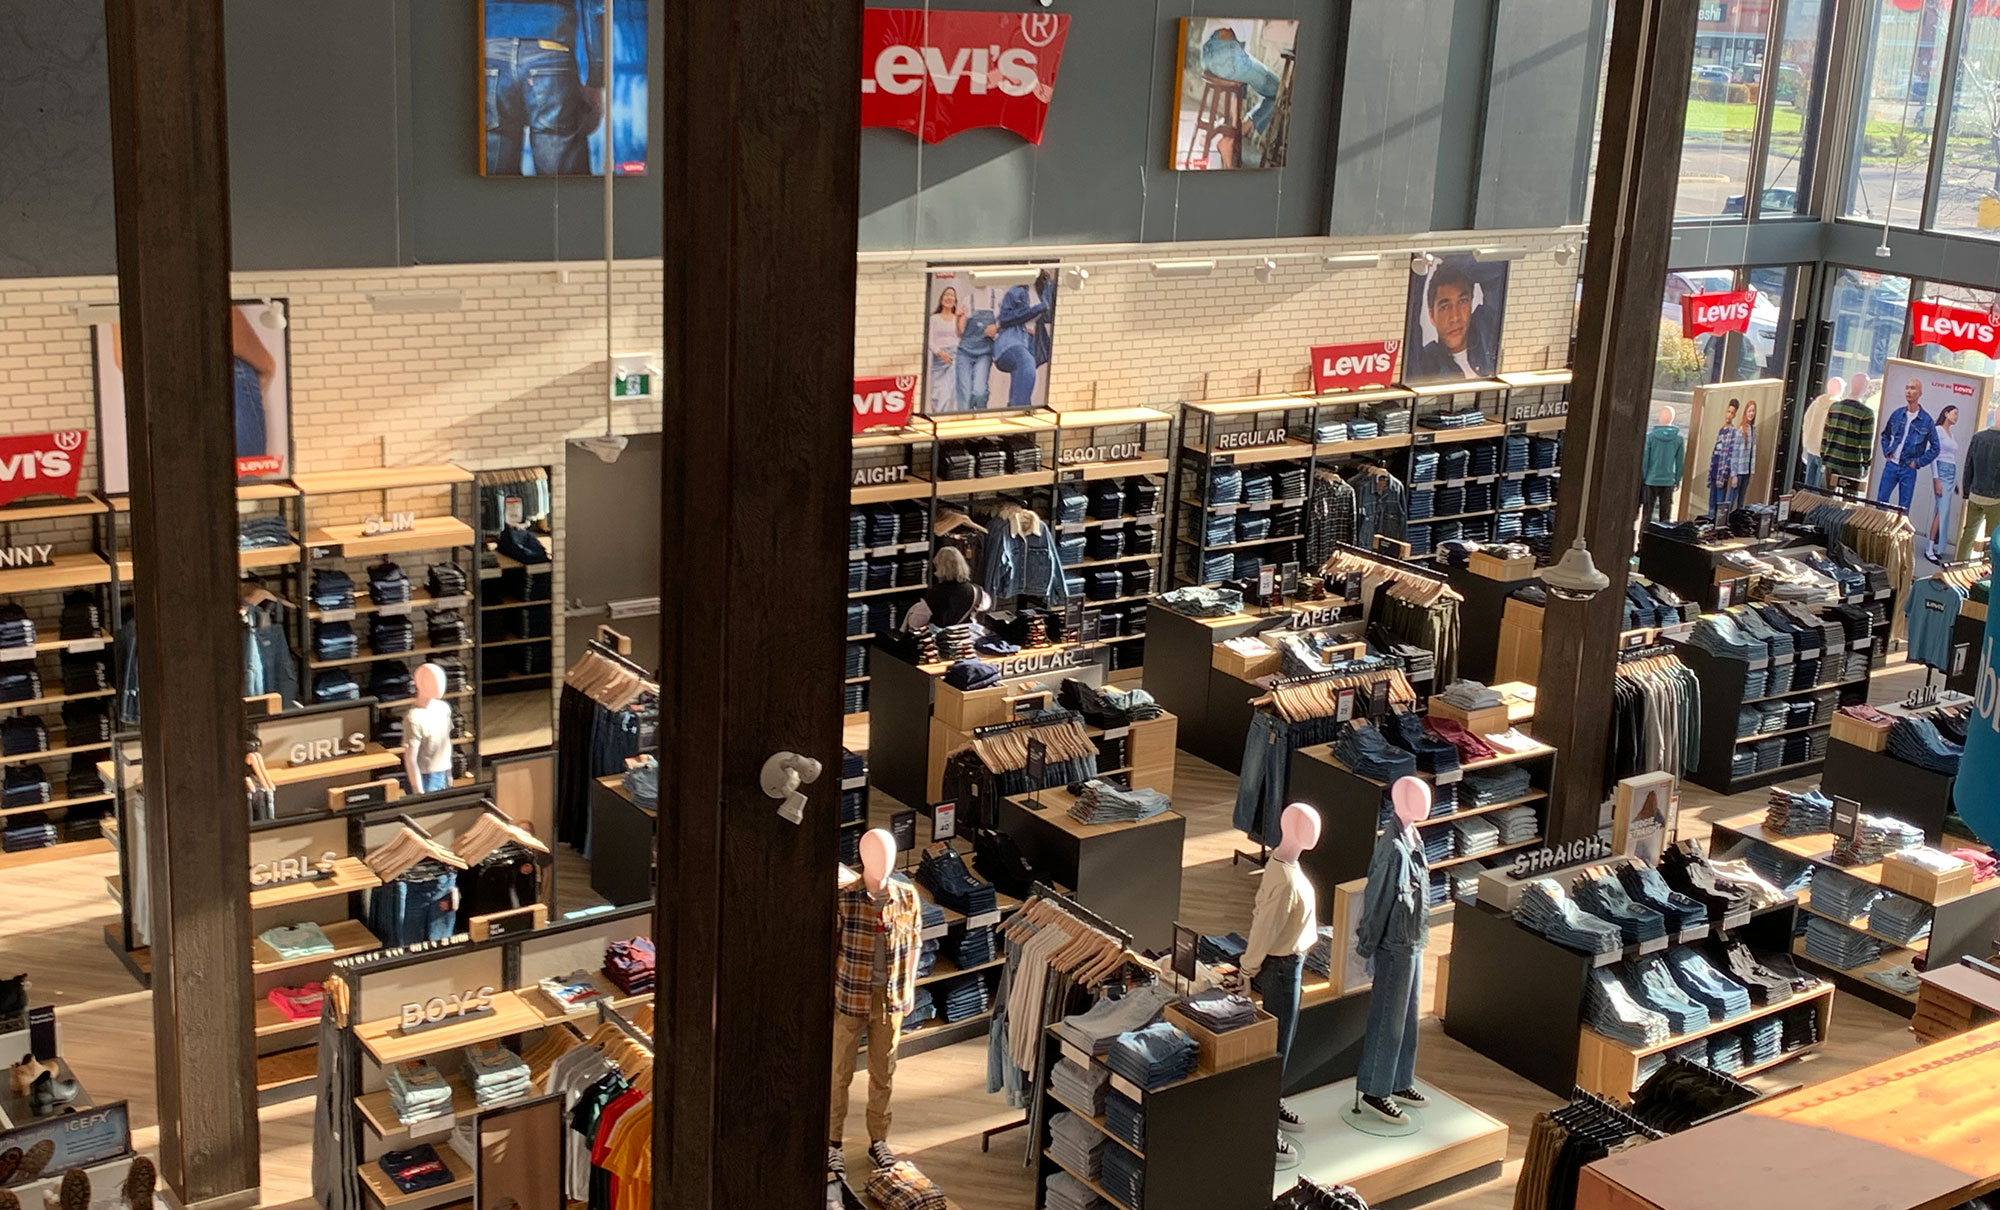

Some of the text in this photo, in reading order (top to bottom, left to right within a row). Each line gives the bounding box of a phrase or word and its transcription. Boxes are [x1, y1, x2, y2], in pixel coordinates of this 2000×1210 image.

[1515, 401, 1569, 419] RELAXED
[1219, 428, 1286, 449] REGULAR
[1063, 442, 1141, 463] BOOT CUT
[854, 465, 908, 485] AIGHT
[364, 511, 414, 533] SLIM
[1292, 606, 1341, 628] TAPER
[1907, 685, 1939, 706] SLIM
[290, 732, 366, 764] GIRLS
[1514, 834, 1611, 876] STRAIGHT
[251, 851, 337, 886] GIRLS
[401, 986, 496, 1030] BOYS
